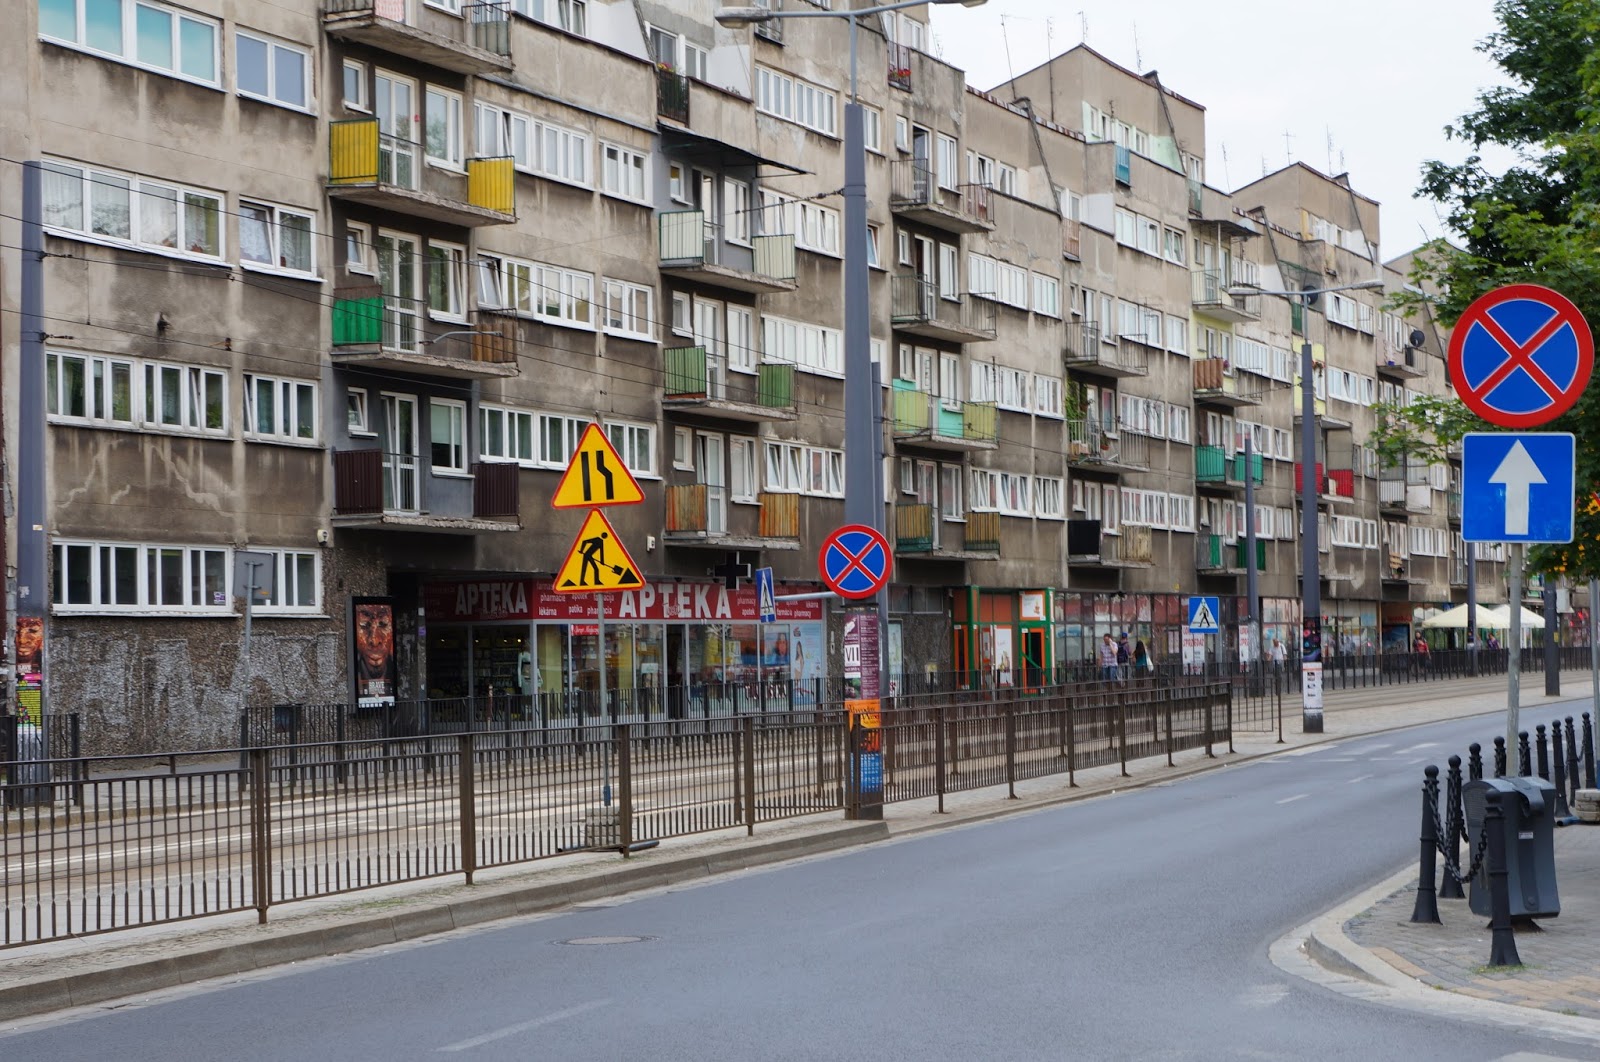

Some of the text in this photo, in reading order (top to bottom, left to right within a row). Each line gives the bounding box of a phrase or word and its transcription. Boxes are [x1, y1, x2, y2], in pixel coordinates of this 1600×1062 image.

[455, 582, 528, 615] APTEKA
[618, 583, 732, 618] APTEKA
[845, 646, 859, 662] VII
